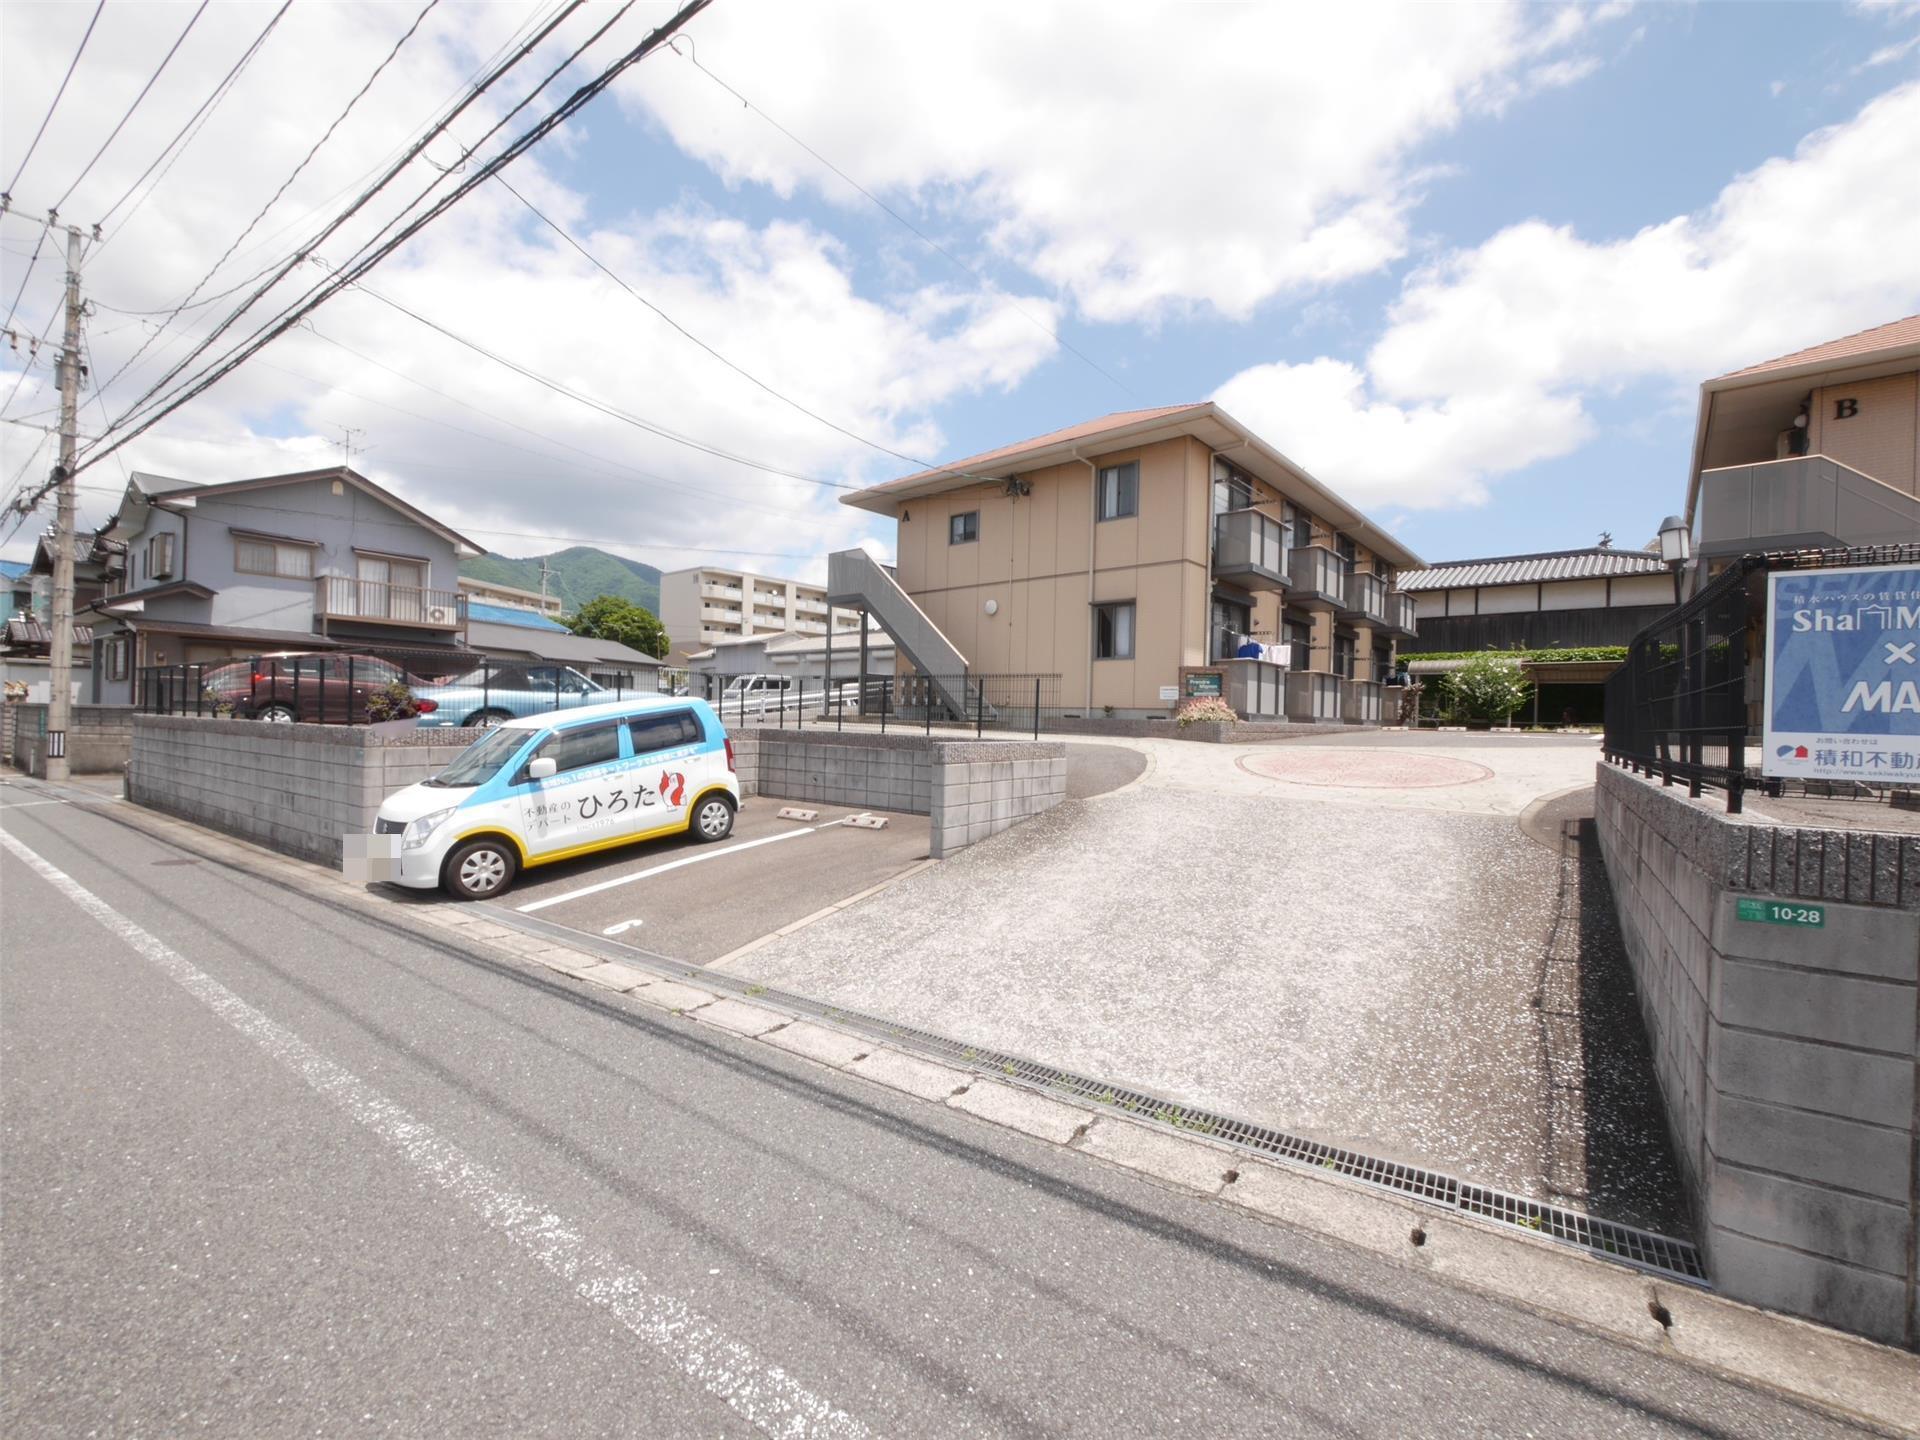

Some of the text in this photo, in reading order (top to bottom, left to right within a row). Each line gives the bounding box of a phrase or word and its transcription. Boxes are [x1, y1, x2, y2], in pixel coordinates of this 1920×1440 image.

[1834, 398, 1858, 420] B
[525, 802, 571, 817] 不動産の
[578, 785, 655, 819] ひろた
[1772, 906, 1820, 924] 10-28
